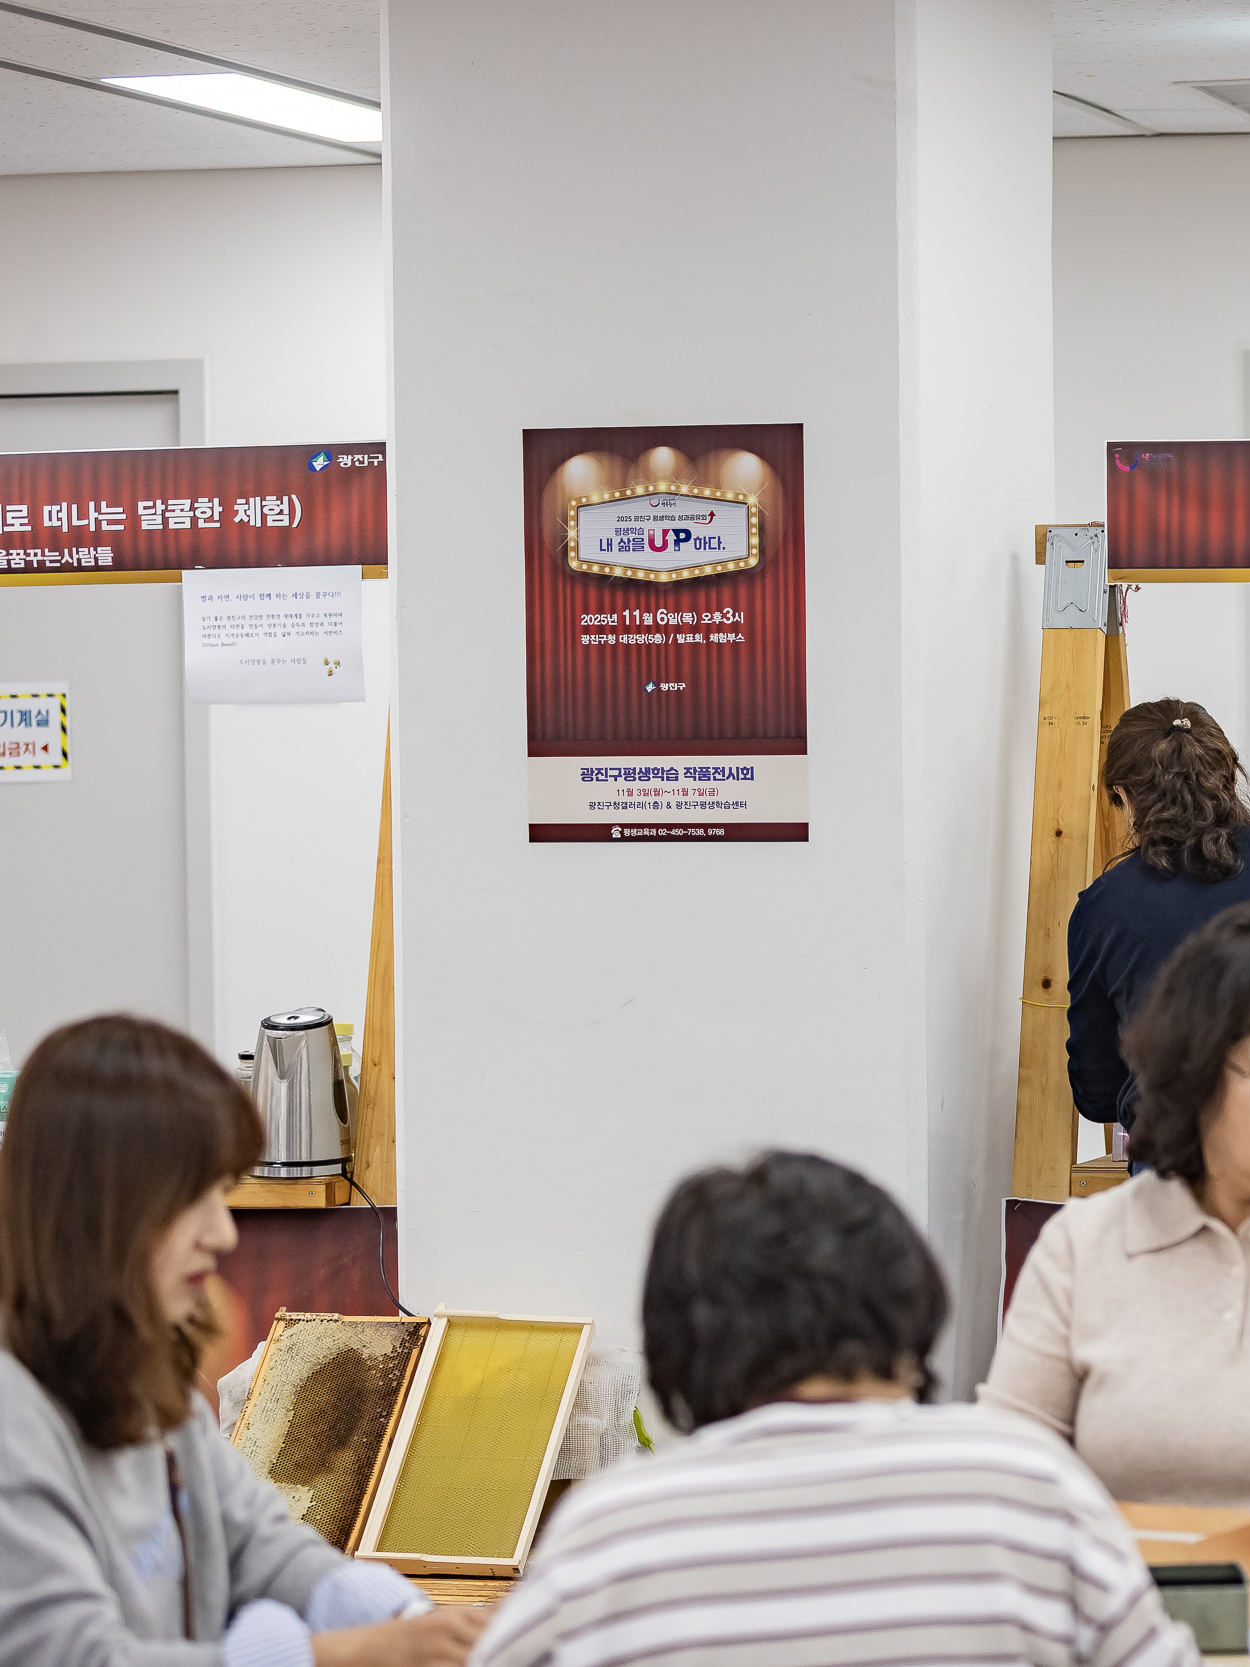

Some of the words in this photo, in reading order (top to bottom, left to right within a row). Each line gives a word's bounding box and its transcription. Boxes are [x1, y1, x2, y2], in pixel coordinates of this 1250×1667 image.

[336, 453, 384, 468] 광진구
[0, 503, 32, 534] 로
[43, 500, 128, 533] 떠나는
[137, 496, 223, 530] 달콤한
[232, 494, 302, 529] 체험)
[652, 514, 676, 522] 평생학습
[614, 527, 645, 536] 평생학습
[599, 537, 613, 552] 내
[617, 537, 645, 552] 삶을
[0, 546, 114, 569] 을꿈꾸는사람들
[580, 613, 618, 626] 2025년
[622, 609, 654, 626] 11월
[656, 608, 698, 626] 6일(목)
[701, 607, 744, 625] 오후3시
[580, 633, 615, 645] 광진구청
[619, 633, 666, 645] 대강당(5층)
[676, 633, 706, 645] 발표회,
[709, 632, 745, 644] 체험부스
[659, 681, 686, 691] 광진구
[0, 708, 50, 729] 기계실
[579, 766, 680, 782] 광진구평생학습
[683, 765, 755, 782] 작품전시회
[616, 787, 634, 797] 11월
[691, 787, 719, 797] 7일(금)
[588, 800, 663, 811] 광진구청갤러리(1층)
[665, 800, 673, 810] &
[675, 800, 748, 810] 광진구평생학습센터
[623, 827, 657, 837] 평생교육과
[658, 827, 706, 838] 02-450-7538,
[707, 827, 725, 836] 9768
